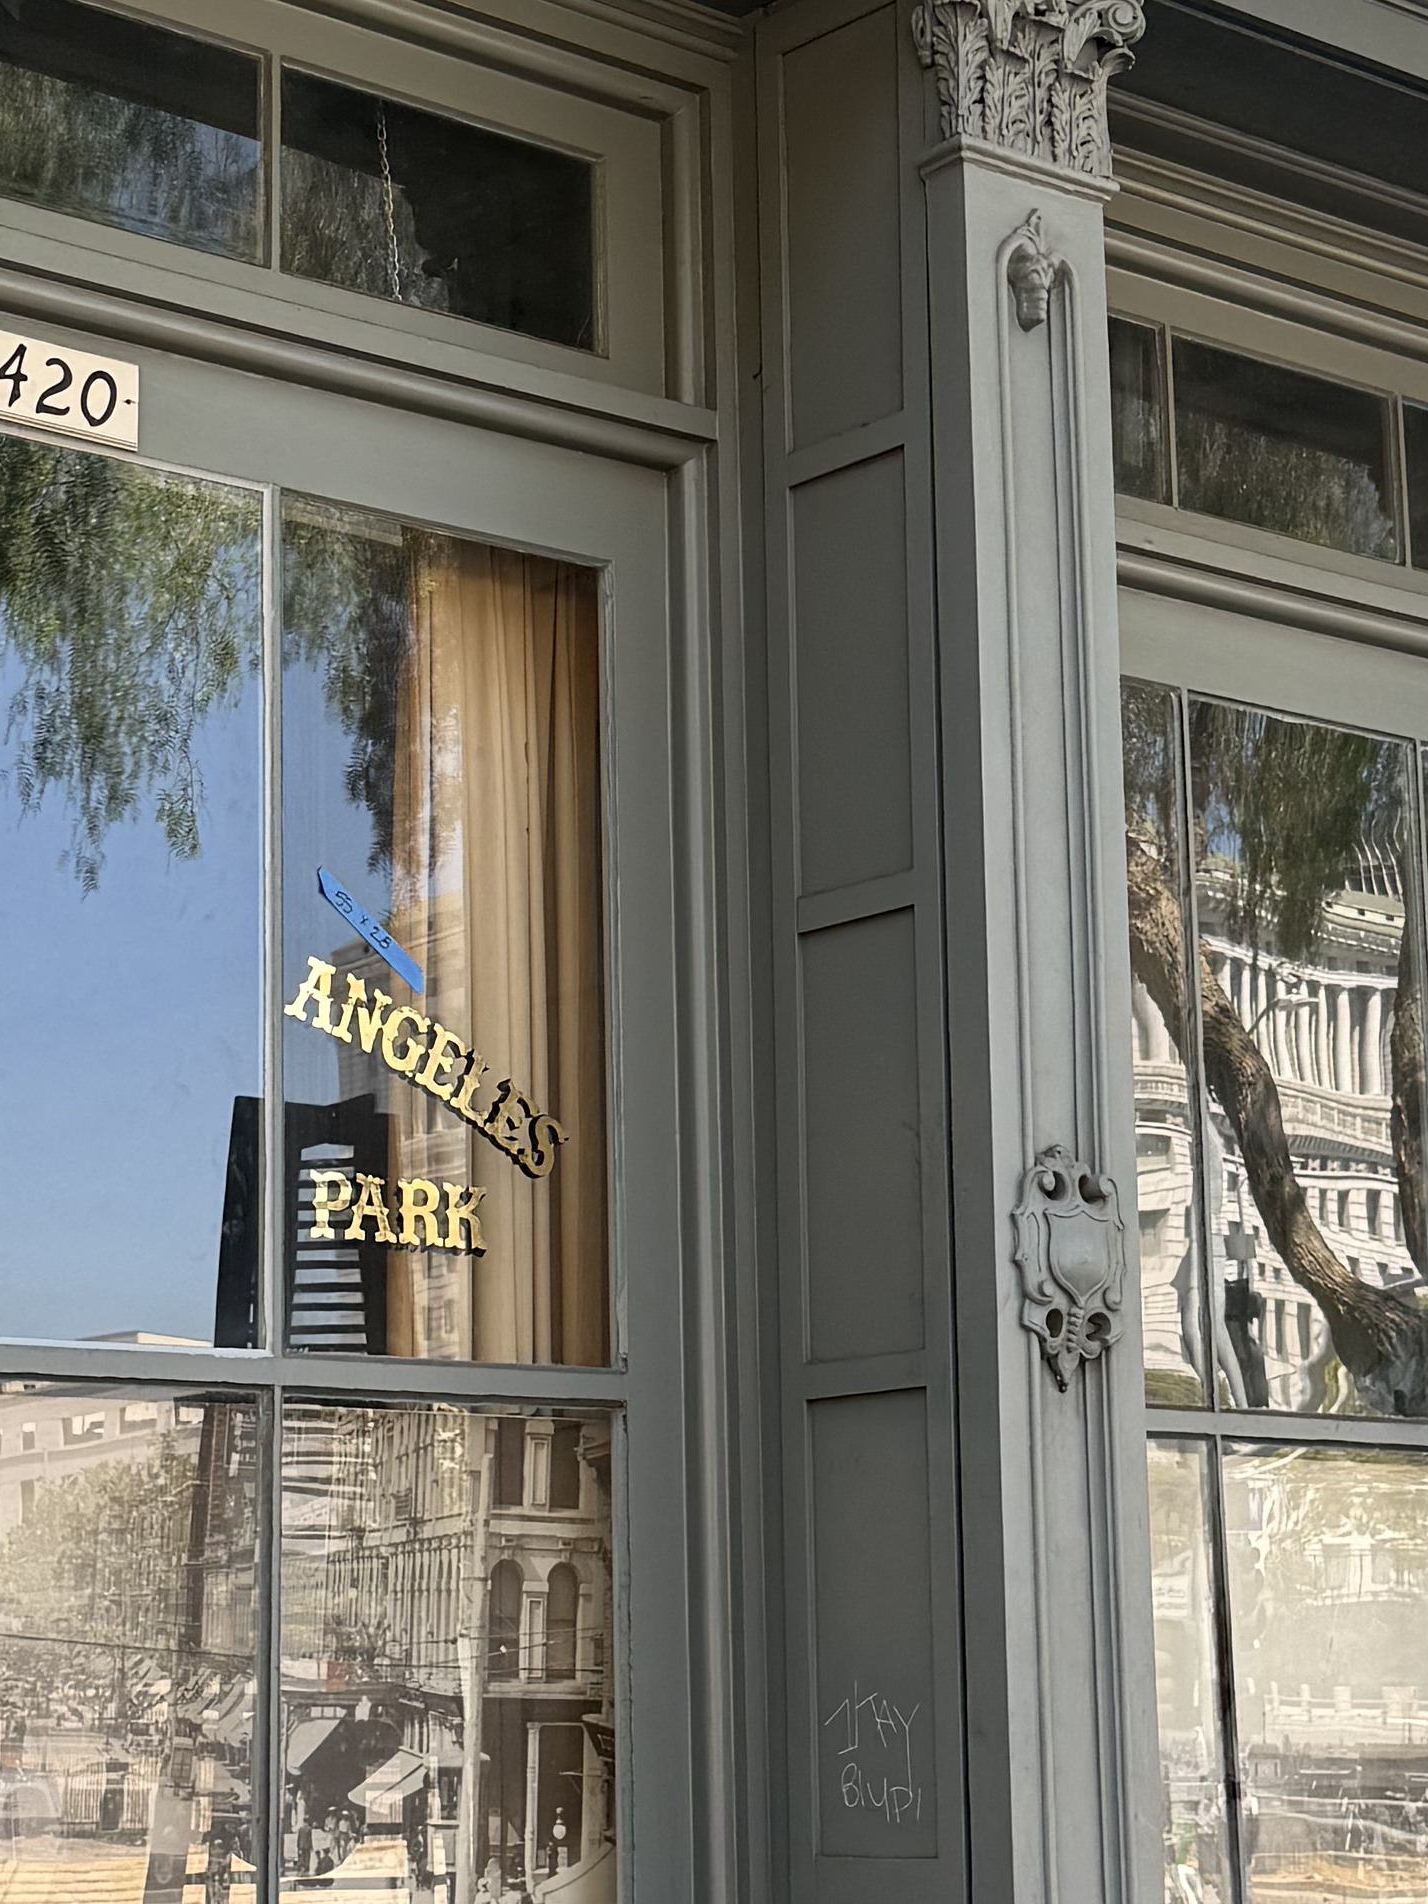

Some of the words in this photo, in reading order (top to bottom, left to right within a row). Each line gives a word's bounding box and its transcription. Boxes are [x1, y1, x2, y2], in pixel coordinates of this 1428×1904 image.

[370, 926, 392, 949] 28
[283, 955, 570, 1179] ANGELES
[310, 1168, 488, 1257] PARK
